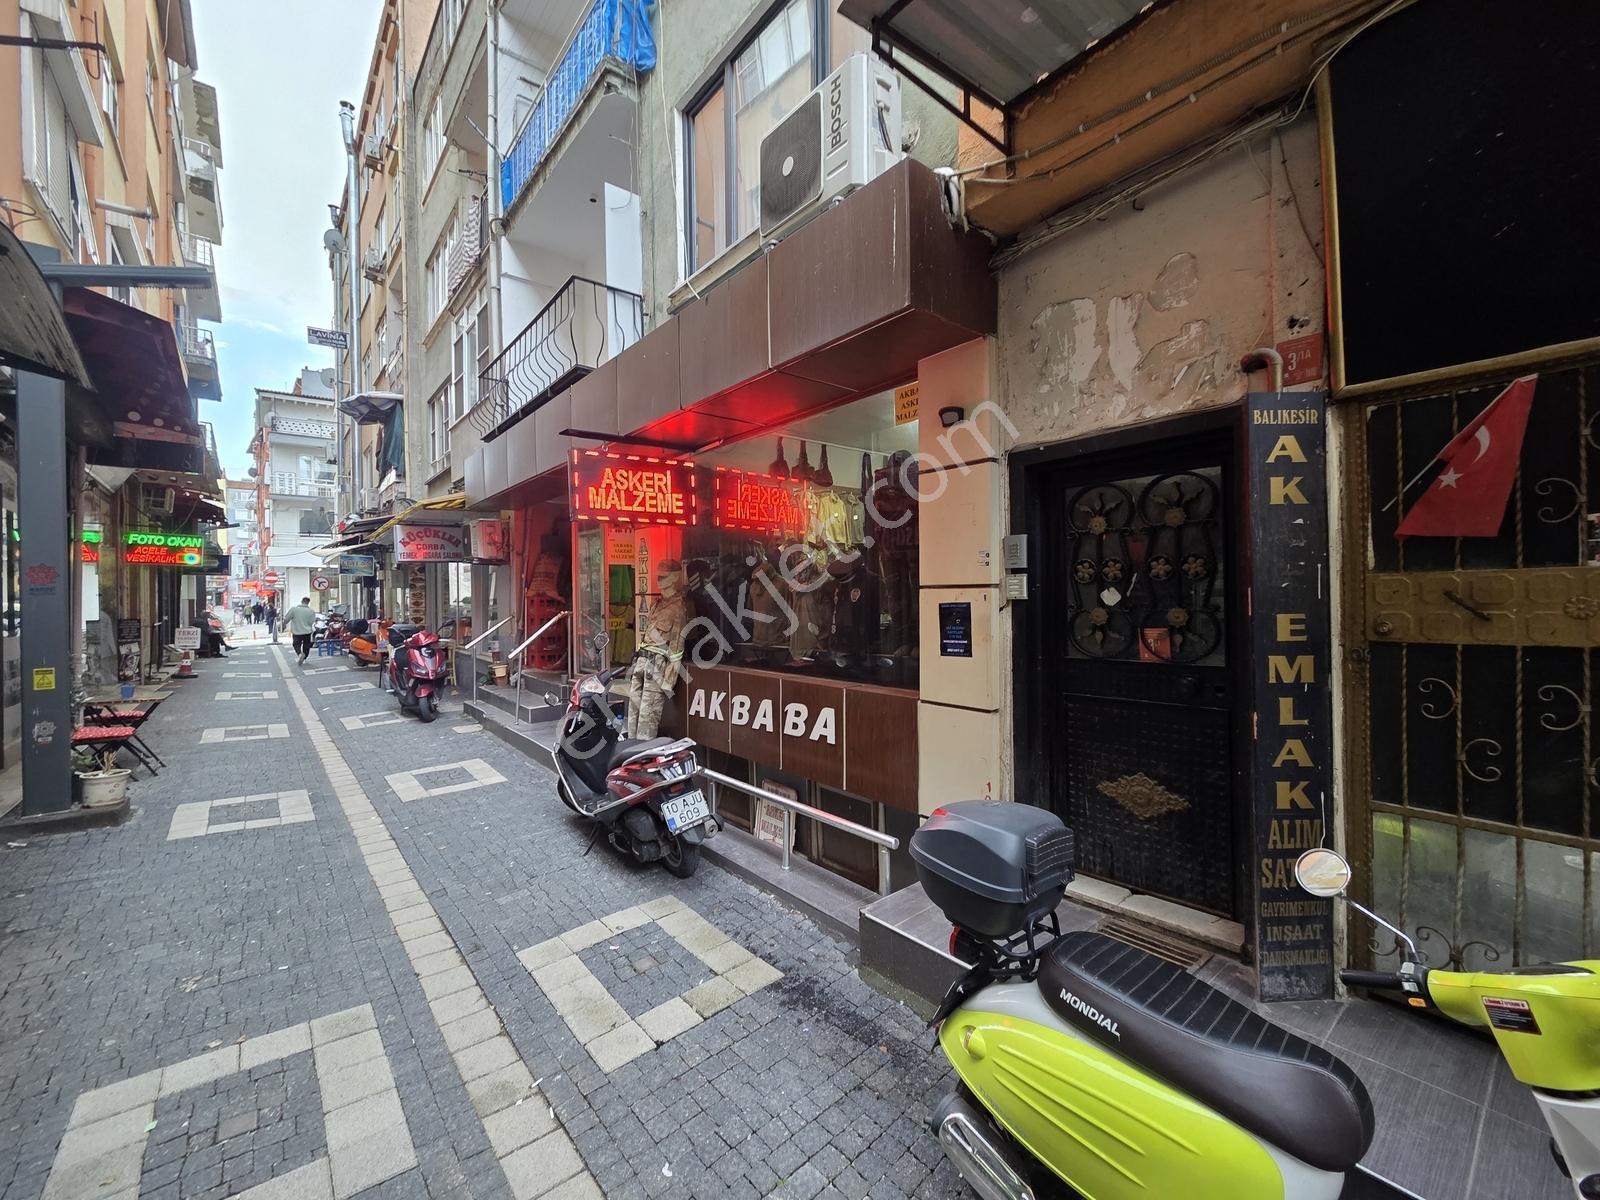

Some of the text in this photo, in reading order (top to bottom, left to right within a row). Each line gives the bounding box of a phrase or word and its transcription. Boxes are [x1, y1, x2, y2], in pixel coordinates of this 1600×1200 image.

[830, 74, 842, 149] BOSCH
[1253, 406, 1319, 426] BALIKESİR
[588, 486, 684, 515] MALZEME
[128, 533, 202, 548] FOTO OKAN
[134, 546, 169, 555] ACELE
[126, 553, 176, 563] VESİKALIK
[688, 688, 837, 745] AKBABA
[1267, 613, 1316, 810] EMLAK
[665, 792, 703, 816] 10 AJU
[679, 806, 701, 824] 609
[1267, 818, 1322, 850] ALIM
[1261, 857, 1298, 889] SAT
[1261, 898, 1329, 918] GAYRİMENKUL
[1265, 922, 1325, 946] İNŞAAT
[1059, 987, 1121, 1040] MONDIAL
